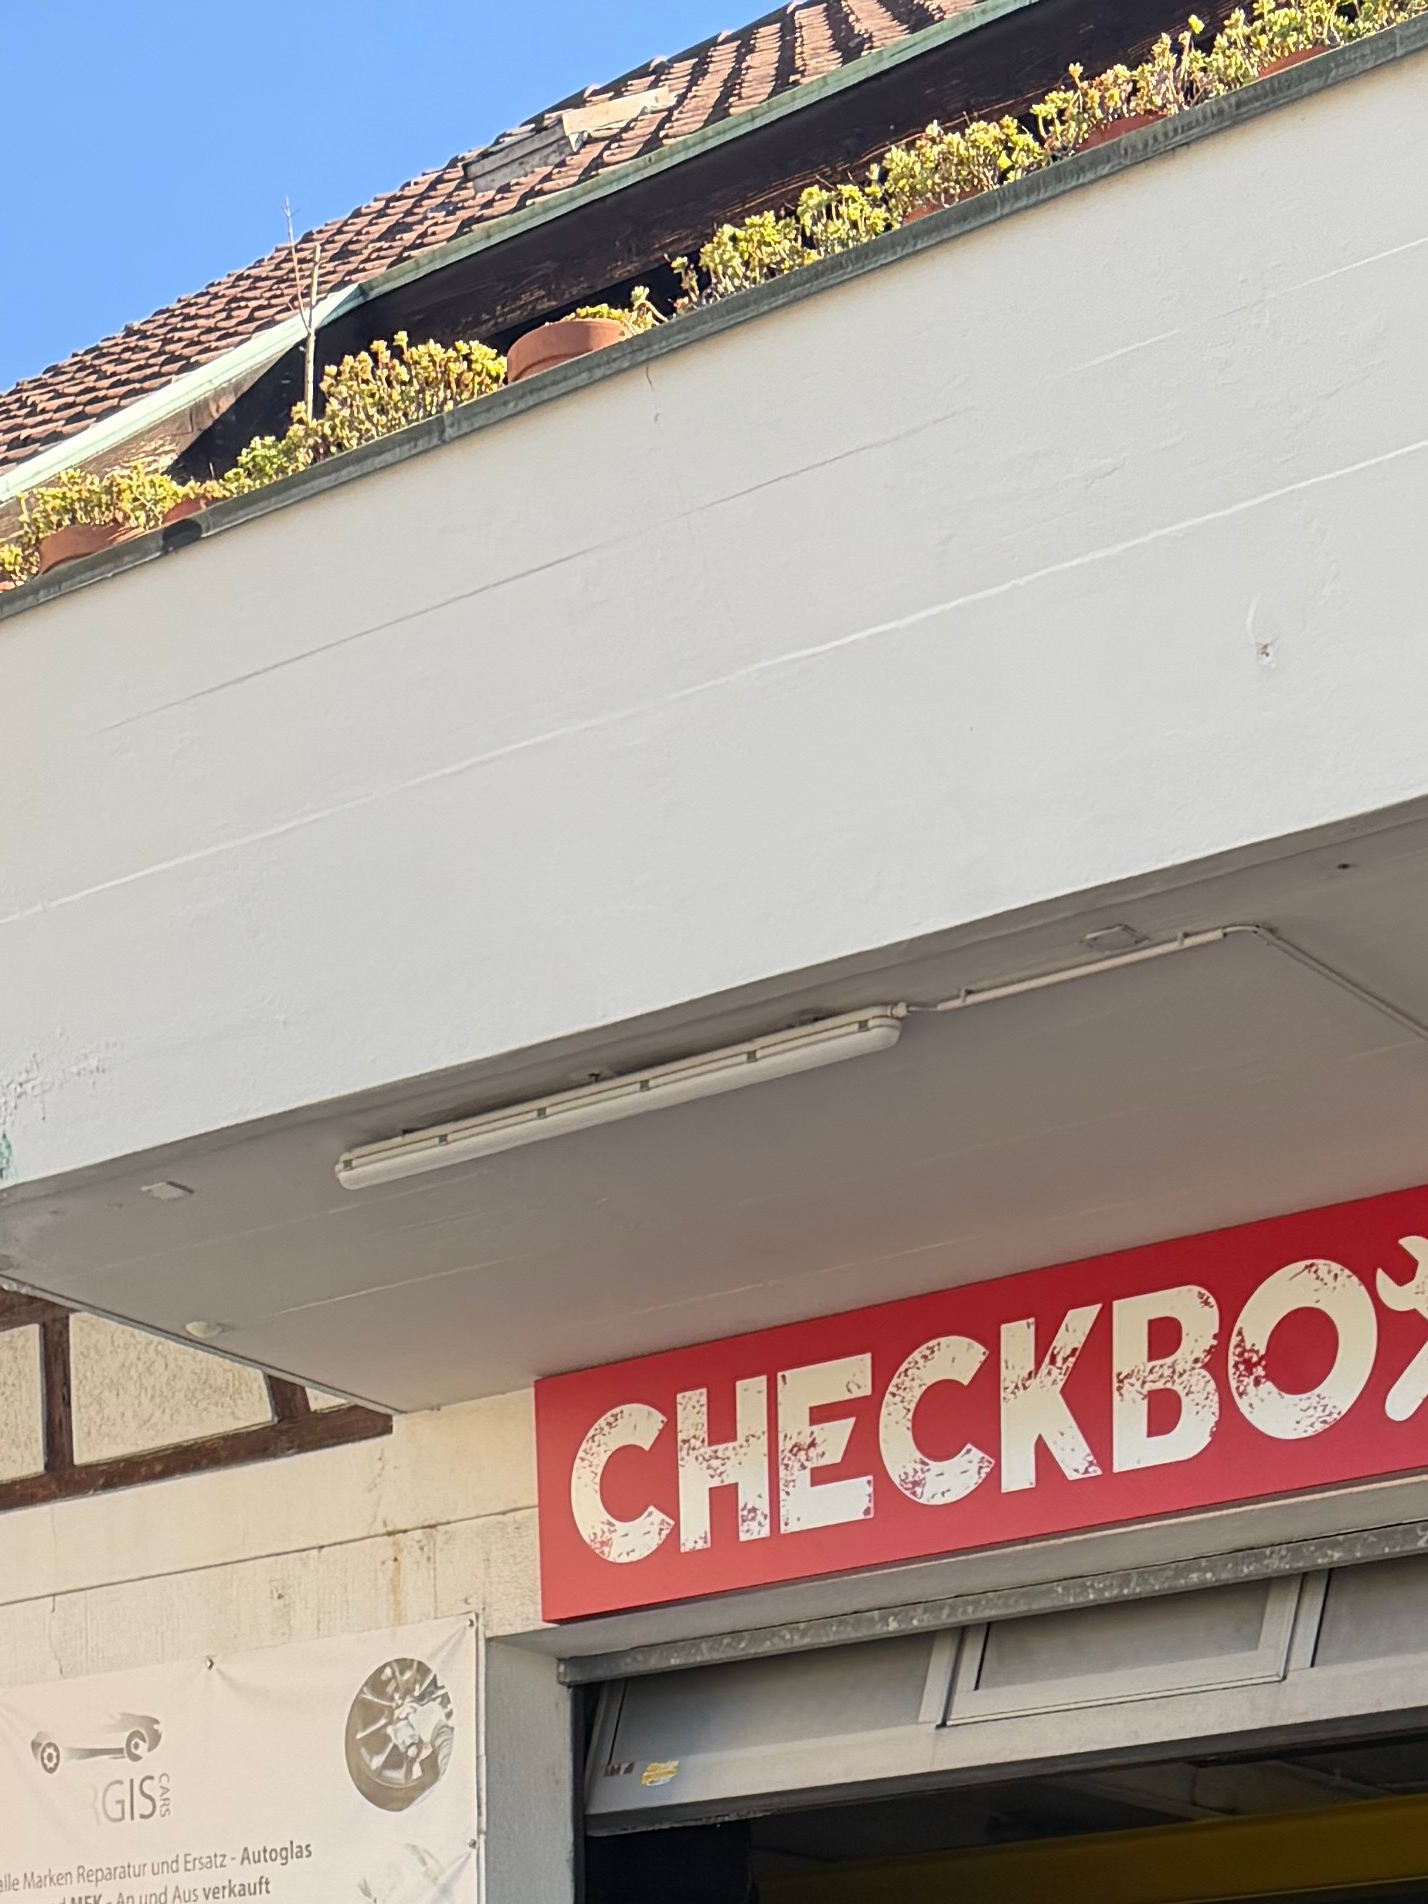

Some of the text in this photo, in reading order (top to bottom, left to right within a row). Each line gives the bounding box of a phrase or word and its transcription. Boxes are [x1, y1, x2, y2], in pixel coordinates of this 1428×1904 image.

[159, 1773, 171, 1817] CARS
[23, 1869, 72, 1890] Marken
[76, 1861, 148, 1887] Reparatur
[151, 1855, 179, 1876] und
[184, 1852, 227, 1872] Ersatz
[240, 1840, 312, 1866] Autoglas
[172, 1885, 199, 1904] Aus
[203, 1876, 271, 1901] verkauft
